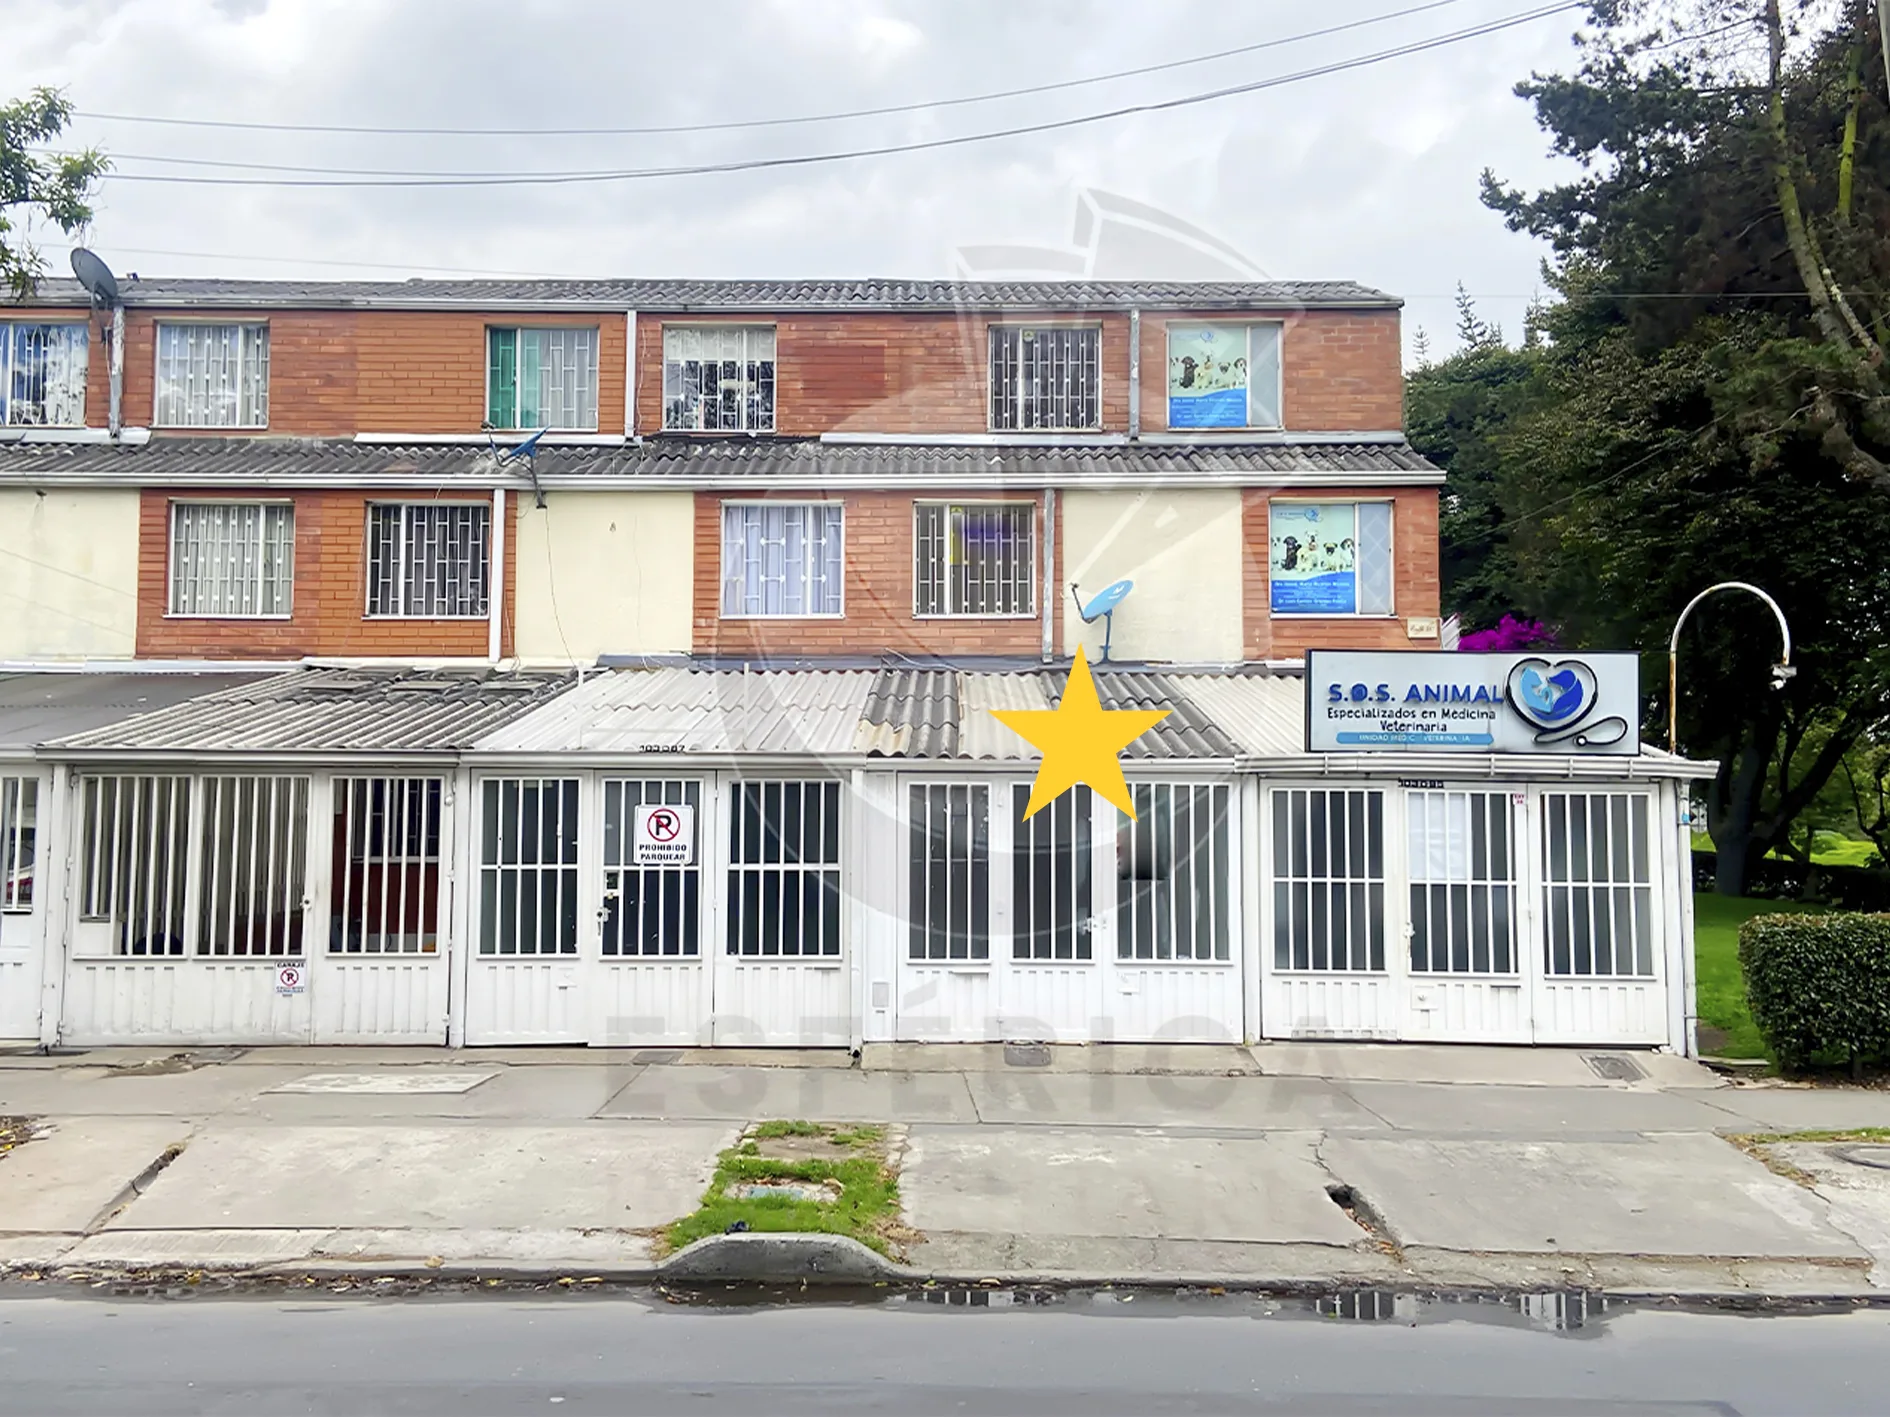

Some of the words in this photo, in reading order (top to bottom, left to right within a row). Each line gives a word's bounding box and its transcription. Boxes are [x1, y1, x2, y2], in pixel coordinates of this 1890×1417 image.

[1328, 683, 1396, 702] S.O.S.
[1403, 684, 1504, 703] ANIMAL
[1327, 707, 1416, 719] Especializados
[1422, 709, 1437, 719] en
[1380, 720, 1447, 732] Veterinaria
